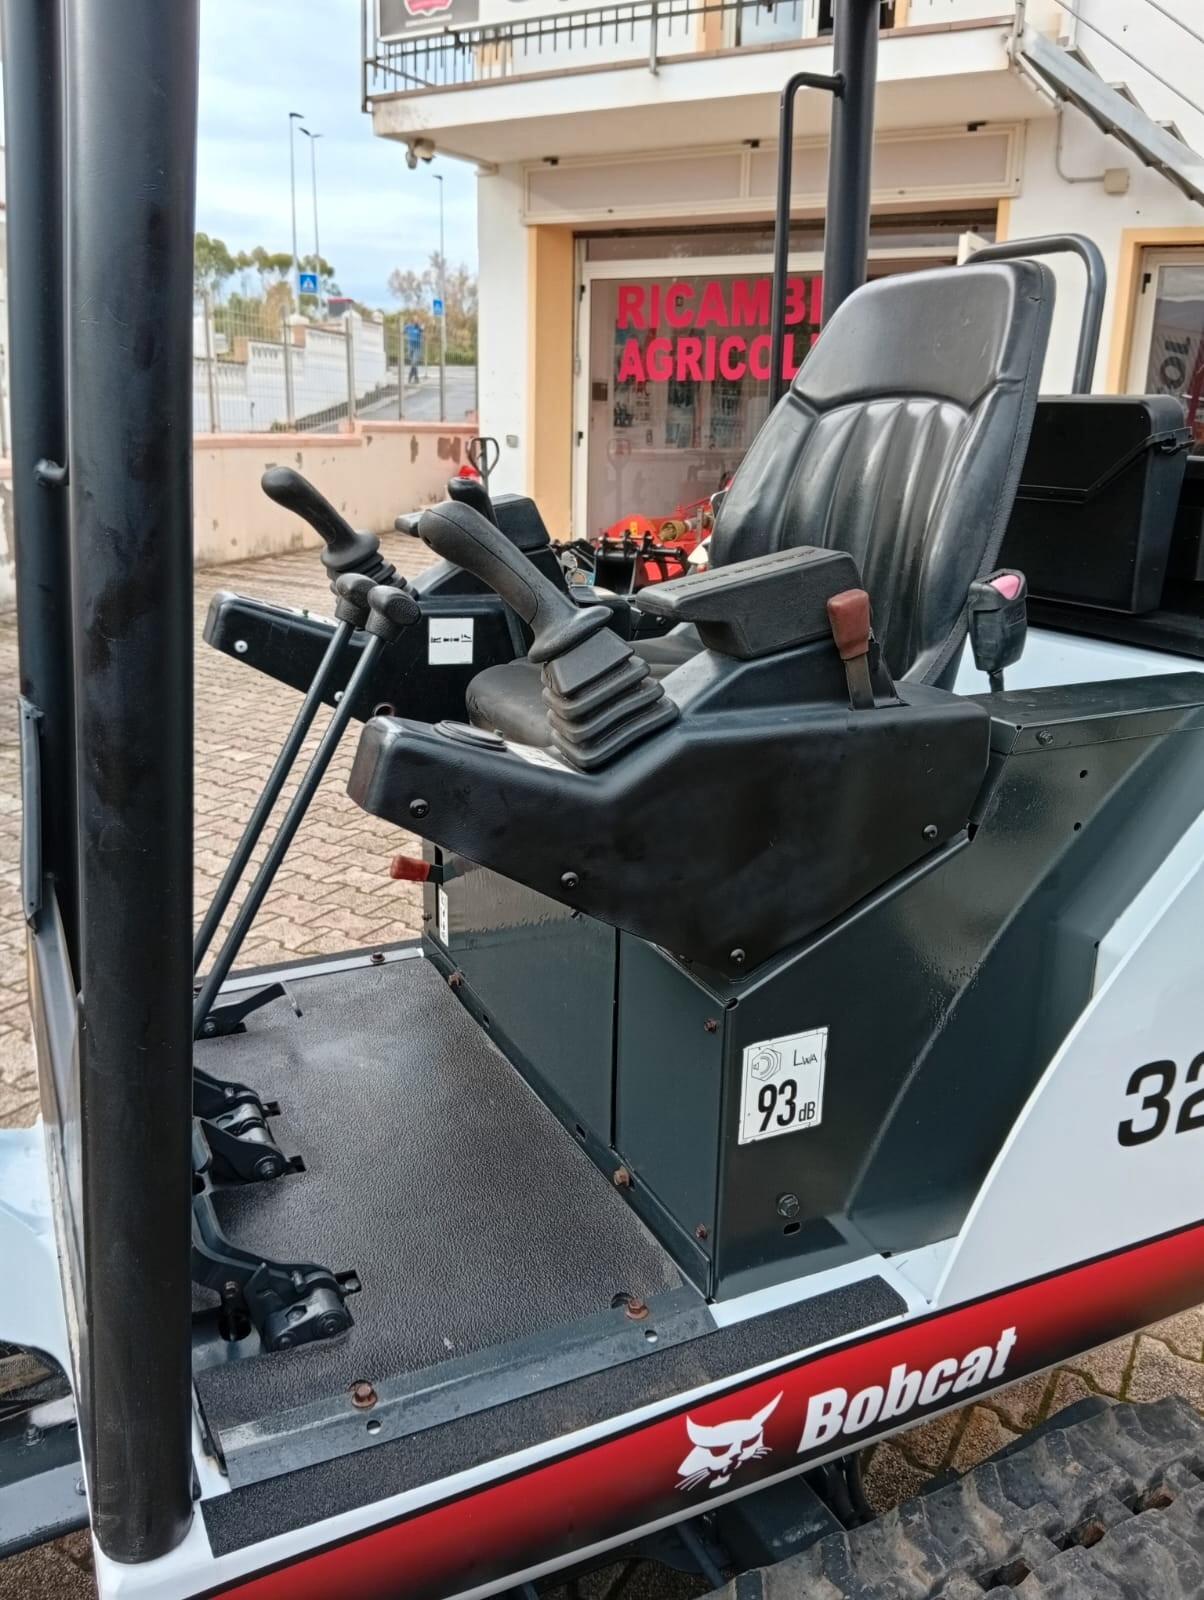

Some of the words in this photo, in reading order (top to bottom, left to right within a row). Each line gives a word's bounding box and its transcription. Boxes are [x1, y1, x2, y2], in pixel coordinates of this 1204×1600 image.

[617, 333, 822, 382] AGRICOL
[758, 1079, 798, 1132] 93
[798, 1101, 816, 1122] dB
[797, 1327, 1017, 1454] Bobcat
